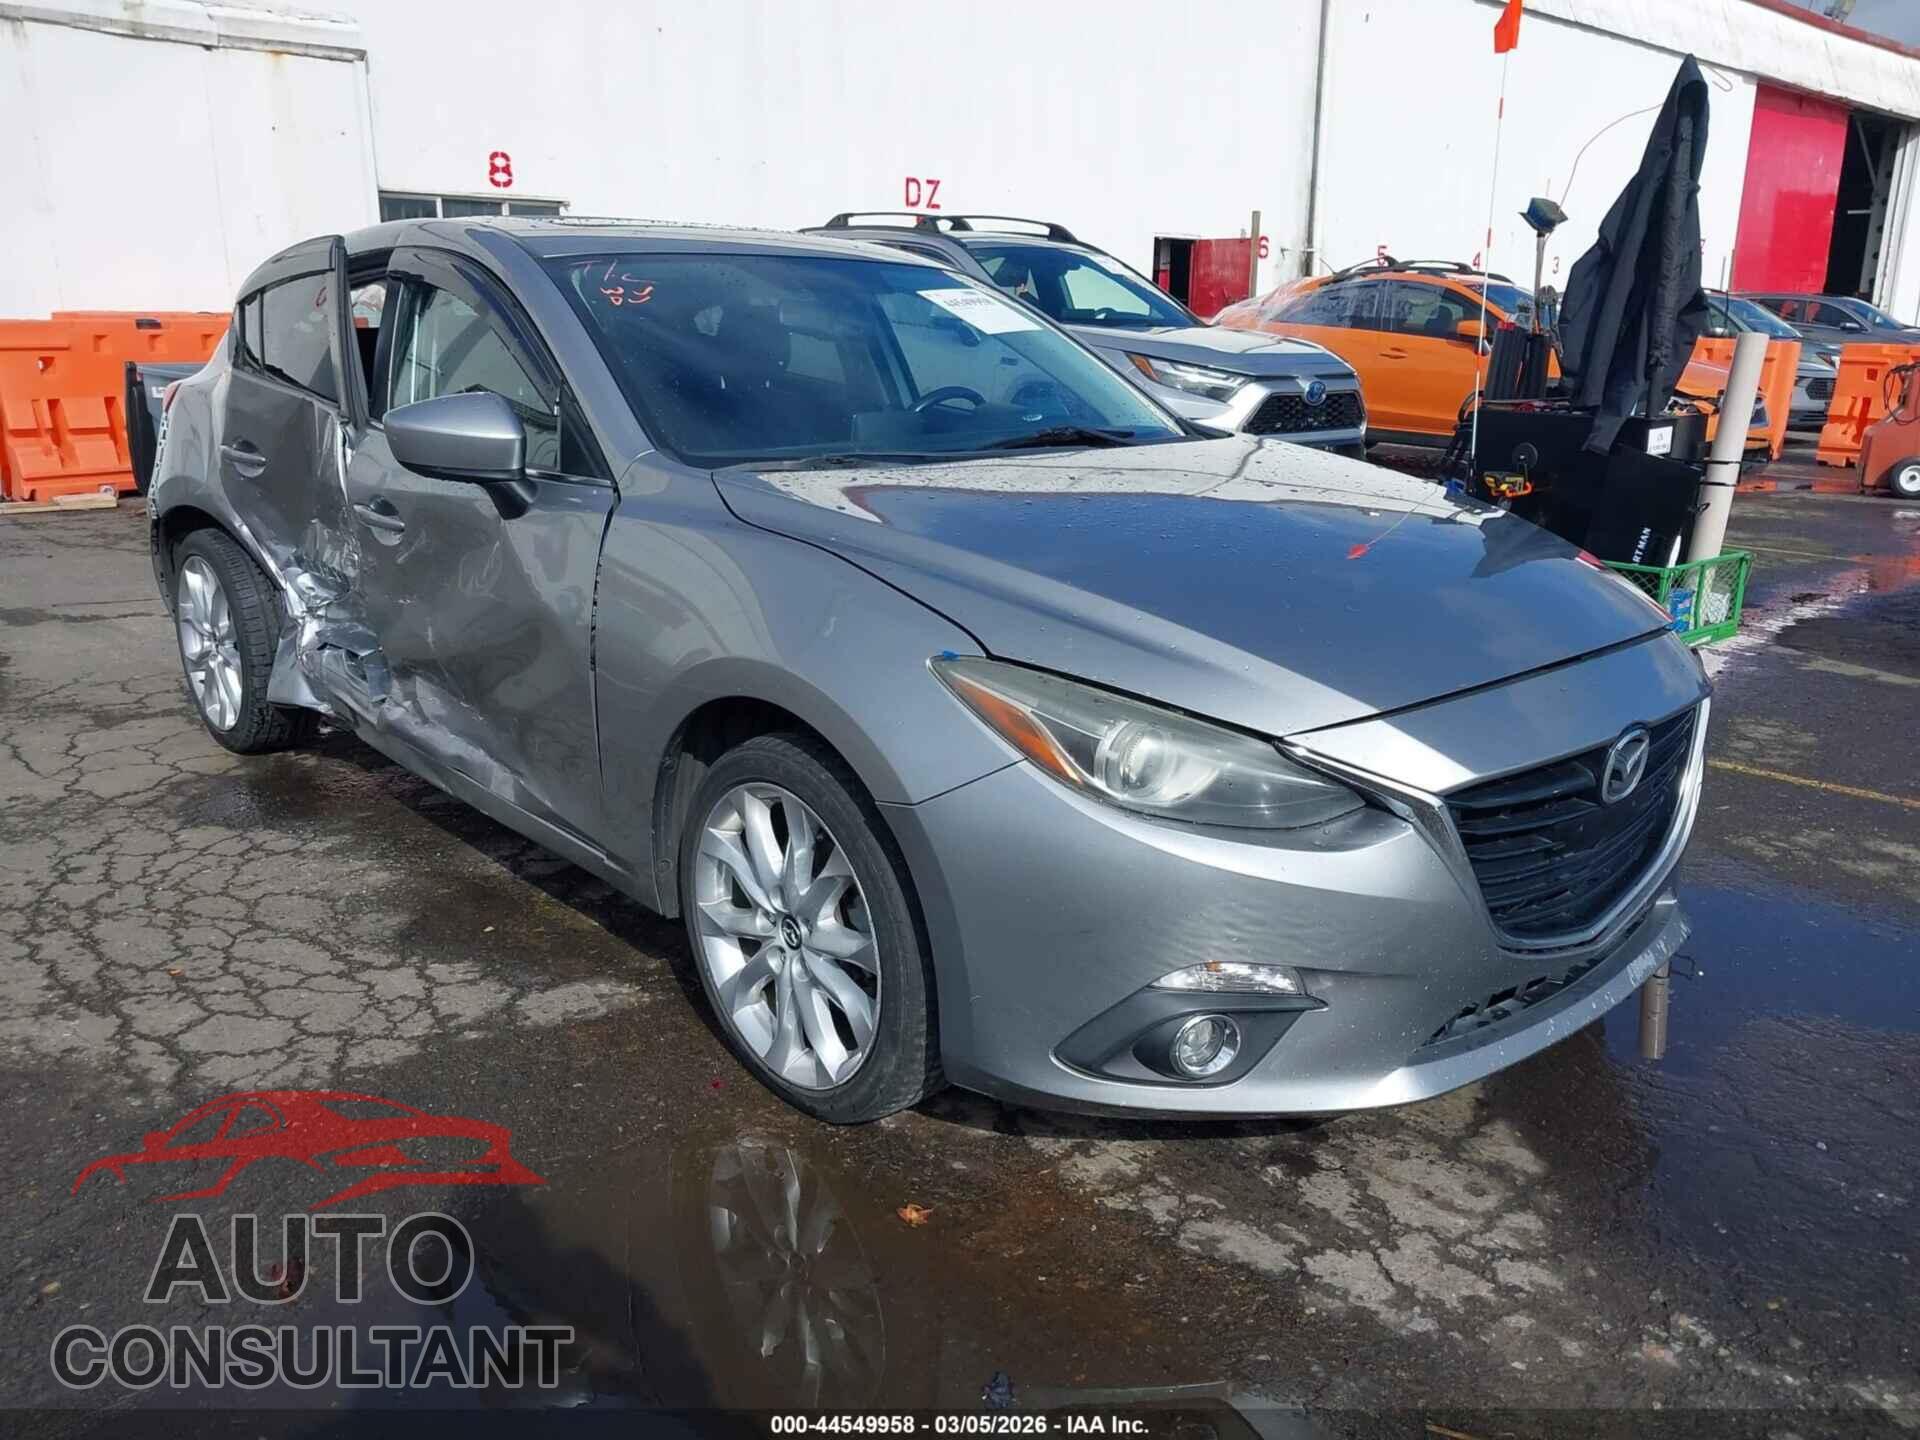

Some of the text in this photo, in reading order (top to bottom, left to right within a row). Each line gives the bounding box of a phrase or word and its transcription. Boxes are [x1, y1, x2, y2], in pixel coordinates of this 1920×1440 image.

[489, 151, 512, 188] 8
[905, 177, 941, 209] DZ
[1257, 236, 1269, 258] 6
[1473, 251, 1481, 271] 4
[1552, 256, 1560, 274] 3
[1632, 527, 1651, 566] RTMAN
